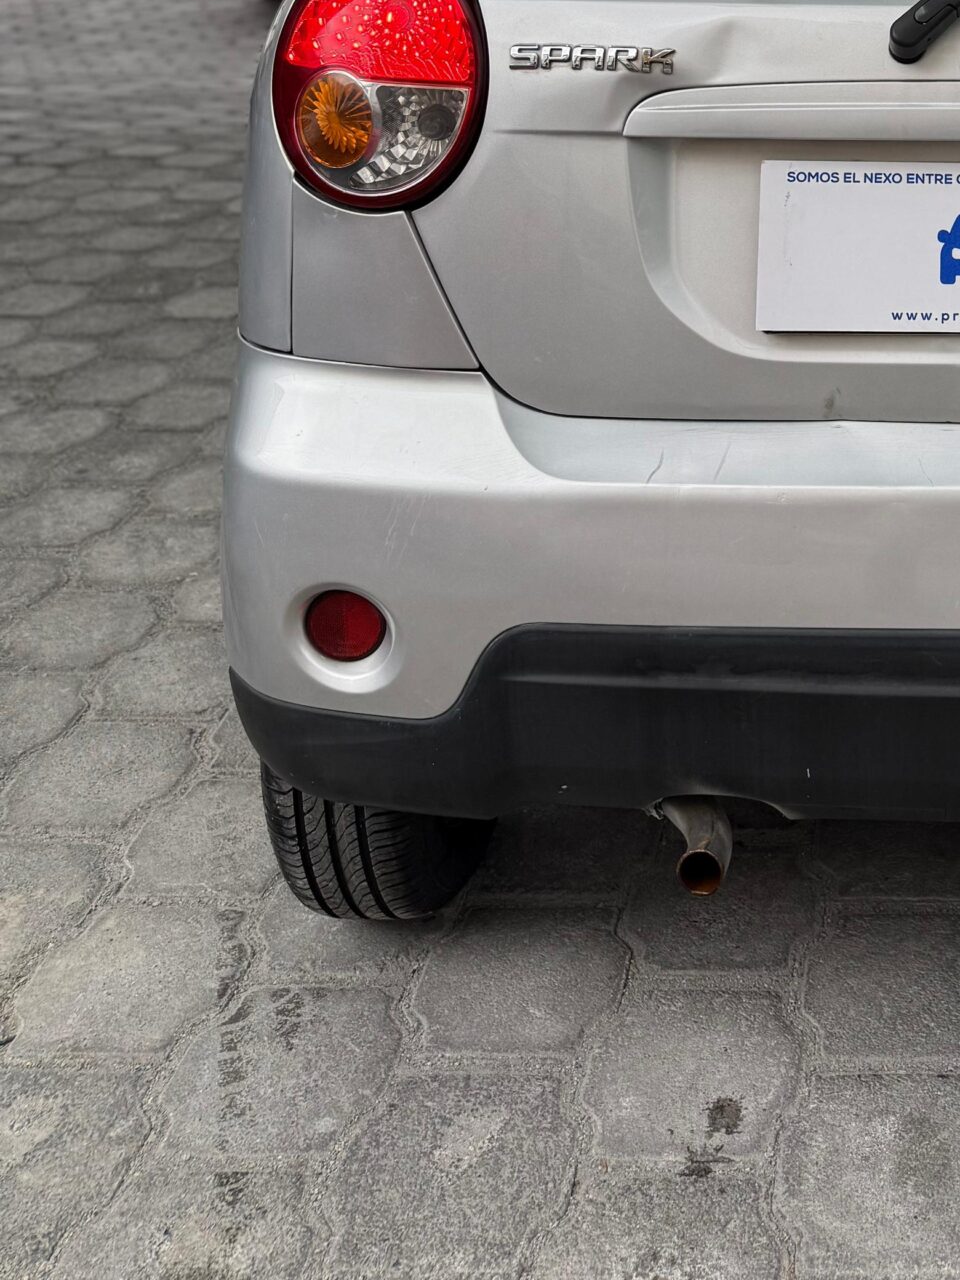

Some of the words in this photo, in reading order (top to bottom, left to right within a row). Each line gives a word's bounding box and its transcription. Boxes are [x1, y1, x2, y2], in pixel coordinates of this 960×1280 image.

[509, 44, 676, 74] SPARK
[787, 171, 840, 184] SOMOS
[843, 172, 861, 184] EL
[863, 172, 903, 185] NEXO
[906, 172, 953, 185] ENTRE
